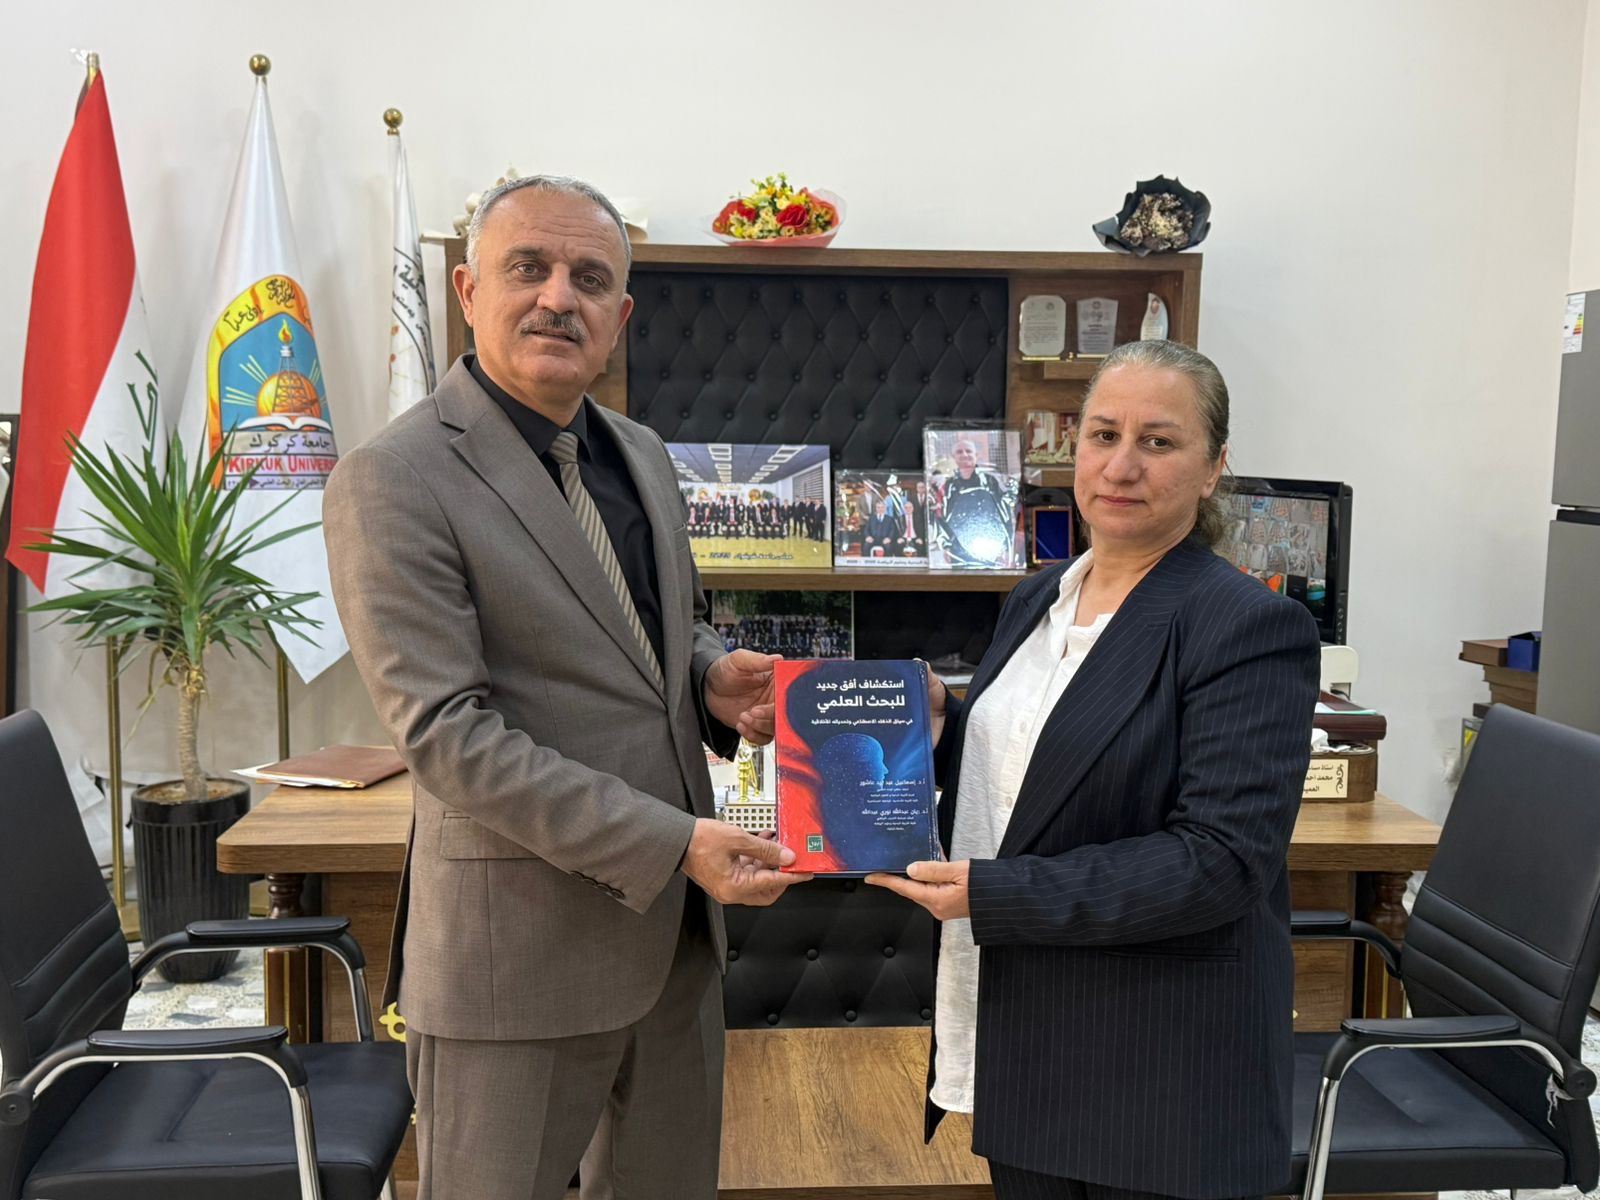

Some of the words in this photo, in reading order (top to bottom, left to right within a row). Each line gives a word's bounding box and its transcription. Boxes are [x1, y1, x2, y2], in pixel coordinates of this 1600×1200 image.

[249, 433, 298, 454] كركوك
[301, 434, 331, 450] جامعة
[287, 455, 337, 473] UNIVER
[816, 681, 838, 691] جديد
[840, 678, 857, 691] أفق
[858, 679, 904, 689] استكشاف
[817, 695, 863, 713] العلمي
[866, 695, 905, 709] للبحث
[1303, 785, 1320, 793] العمي
